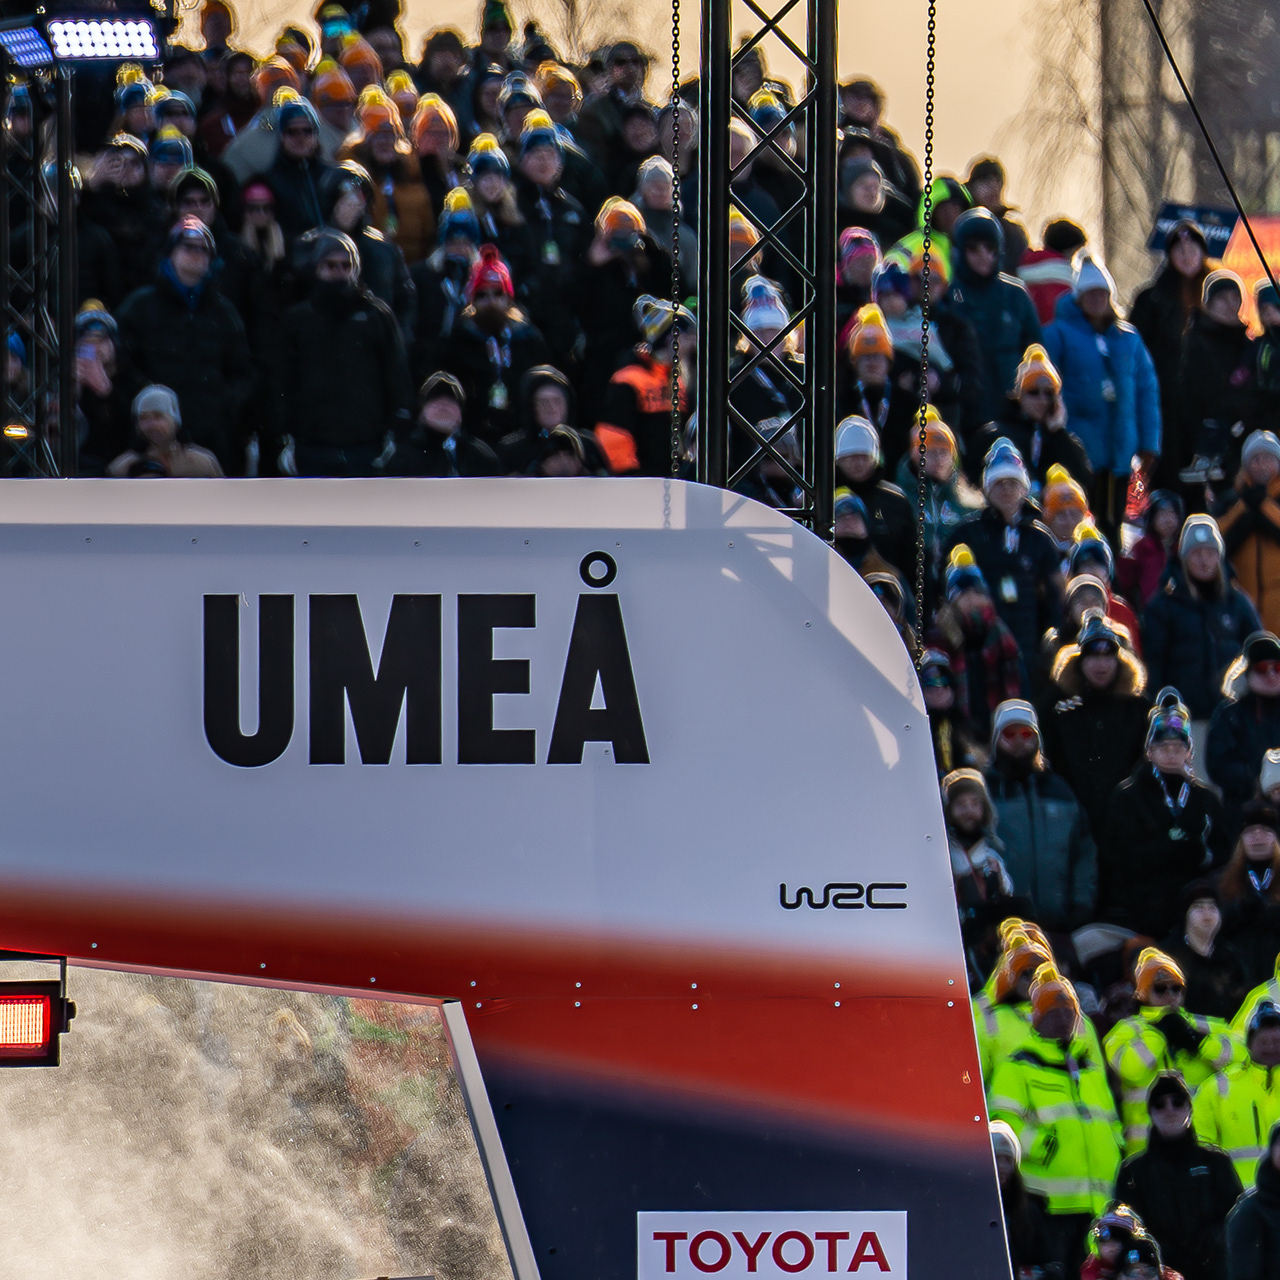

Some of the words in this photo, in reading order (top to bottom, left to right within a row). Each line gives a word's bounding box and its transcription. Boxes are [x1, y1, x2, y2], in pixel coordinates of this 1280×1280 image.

[203, 550, 651, 768] UMEÅ
[779, 882, 908, 910] WRC
[653, 1230, 890, 1273] TOYOTA
